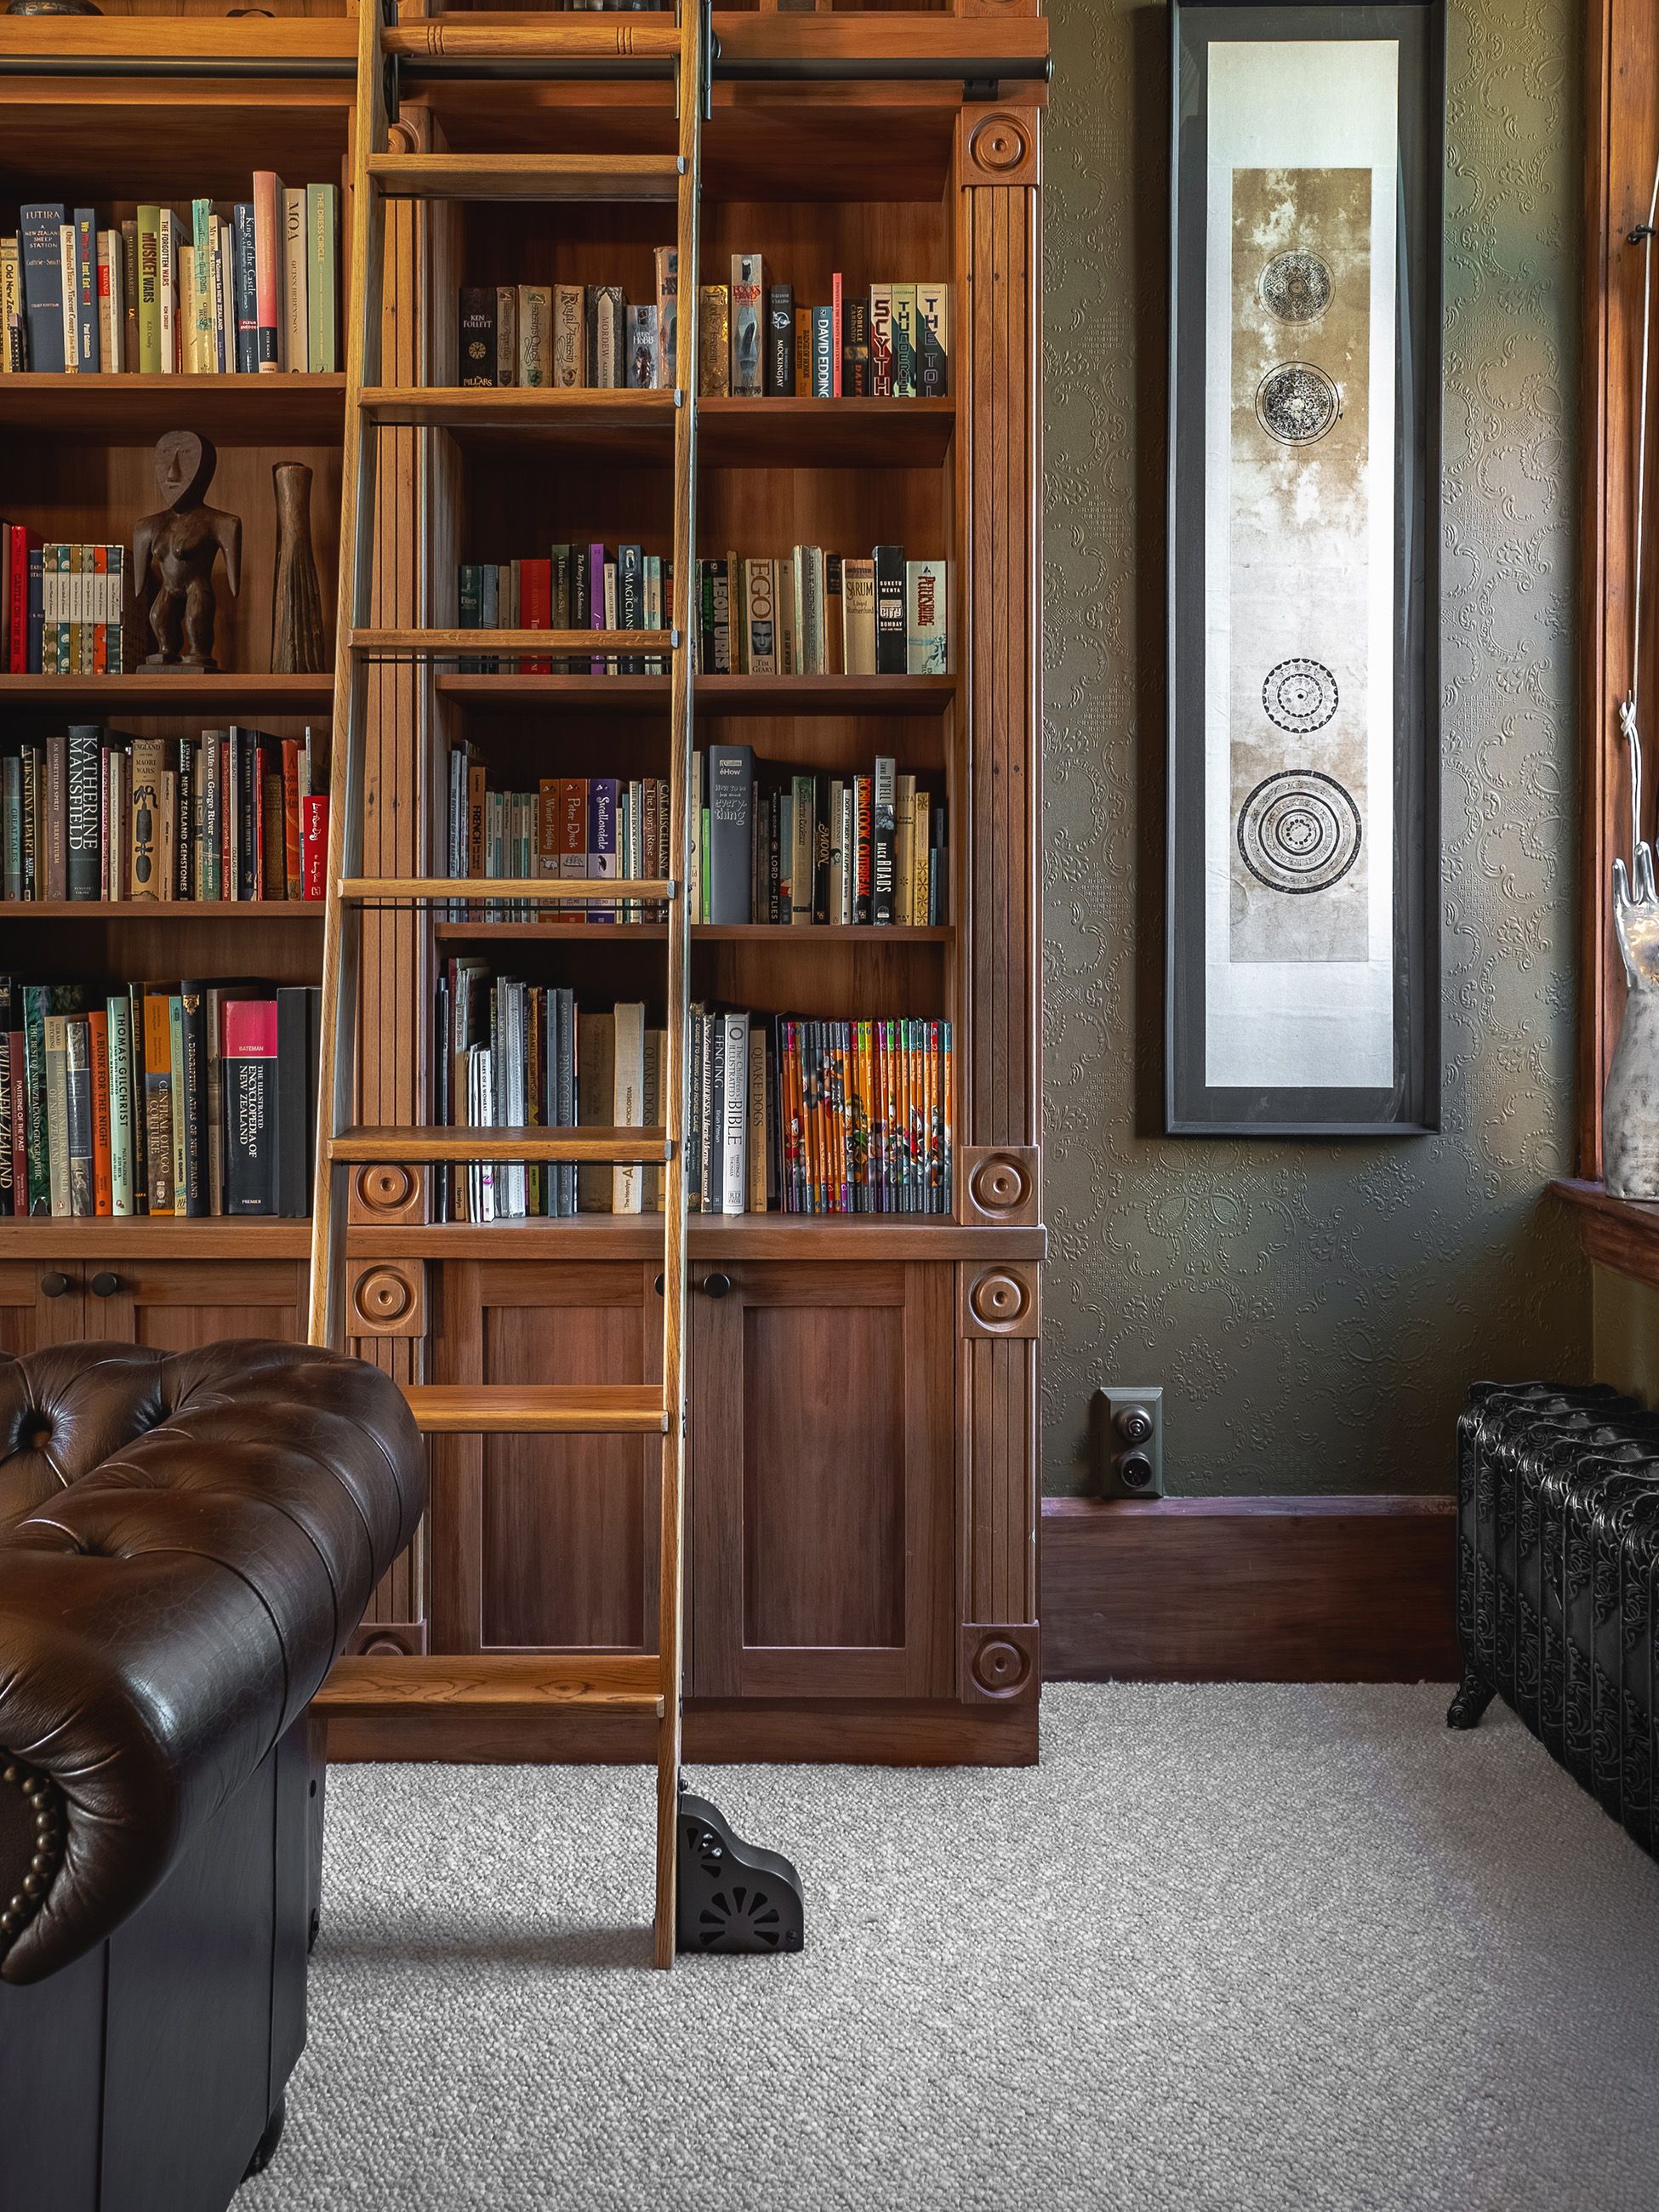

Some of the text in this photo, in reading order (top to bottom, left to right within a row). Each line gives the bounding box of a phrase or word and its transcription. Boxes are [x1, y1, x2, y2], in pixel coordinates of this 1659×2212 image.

[245, 217, 254, 237] King
[247, 241, 255, 249] of
[288, 202, 299, 241] MOA
[142, 232, 157, 303] MUSKET WARS
[247, 253, 255, 265] the
[463, 320, 492, 328] FOLLETT
[818, 320, 829, 354] DAVID
[463, 379, 492, 388] PILLARS
[750, 561, 772, 619] EGO
[847, 582, 873, 600] SARUM
[918, 576, 935, 627] PETERSBURG
[713, 577, 728, 669] LEON URIS
[54, 744, 59, 752] AN
[24, 760, 32, 813] DESTINY
[69, 737, 83, 850] MANSFIELD
[83, 737, 98, 849] KATHERINE
[206, 781, 215, 808] Gorge
[208, 768, 214, 779] on
[472, 806, 482, 844] FRENCH
[544, 798, 555, 850] Winter Holiday
[567, 798, 580, 848] Peter Duck
[596, 796, 610, 850] Swallowdale
[645, 789, 655, 856] The Ivory Rose
[798, 788, 807, 818] Catherine
[25, 817, 33, 856] APART
[659, 808, 668, 870] MISCELLANY
[818, 823, 830, 864] MOON
[857, 778, 870, 896] ROBIN COOK OUTBREAK
[876, 842, 892, 892] BACK ROADS
[97, 1039, 105, 1068] BUNK
[117, 1012, 128, 1127] THOMAS GILCHRIST
[188, 1043, 197, 1092] DESCRIPTIVE
[715, 1035, 724, 1088] FENCING
[49, 1089, 56, 1101] OF
[559, 1054, 570, 1121] PINOCCHIO
[735, 1061, 744, 1097] Children's
[752, 1046, 764, 1127] QUAKE DOGS
[0, 1045, 12, 1189] WILD NEW ZEALAND
[17, 1113, 23, 1121] OF
[150, 1100, 159, 1154] COUTURE
[158, 1080, 169, 1173] CENTRAL OTAGO
[190, 1125, 197, 1135] OF
[240, 1065, 248, 1145] NEW ZEALAND
[248, 1065, 257, 1158] ENCYCLOPEDIA OF
[727, 1100, 742, 1145] BIBLE
